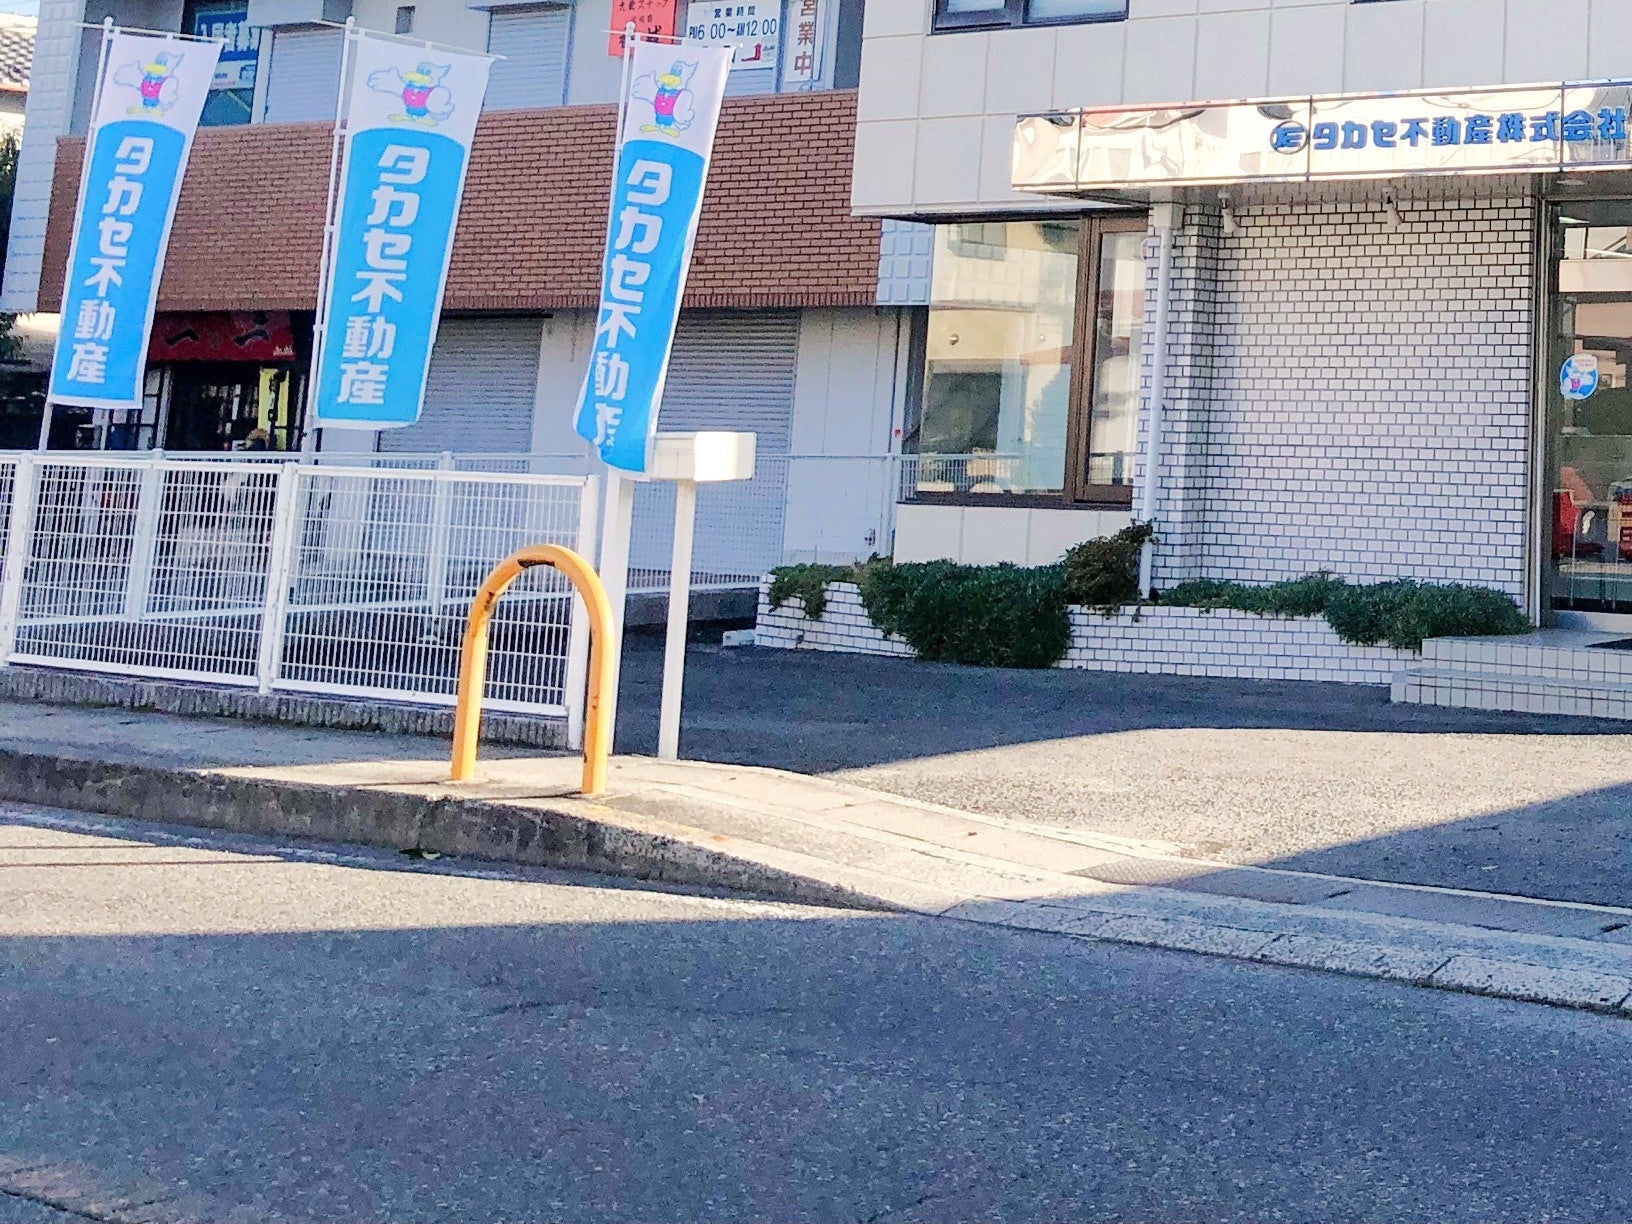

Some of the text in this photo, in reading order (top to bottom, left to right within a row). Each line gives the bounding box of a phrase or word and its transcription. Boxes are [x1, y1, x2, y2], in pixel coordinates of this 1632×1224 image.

[1312, 107, 1626, 151] タカセ不動産株式会社
[65, 136, 155, 386] タカセ不動産
[336, 143, 431, 407] タカセ不動産
